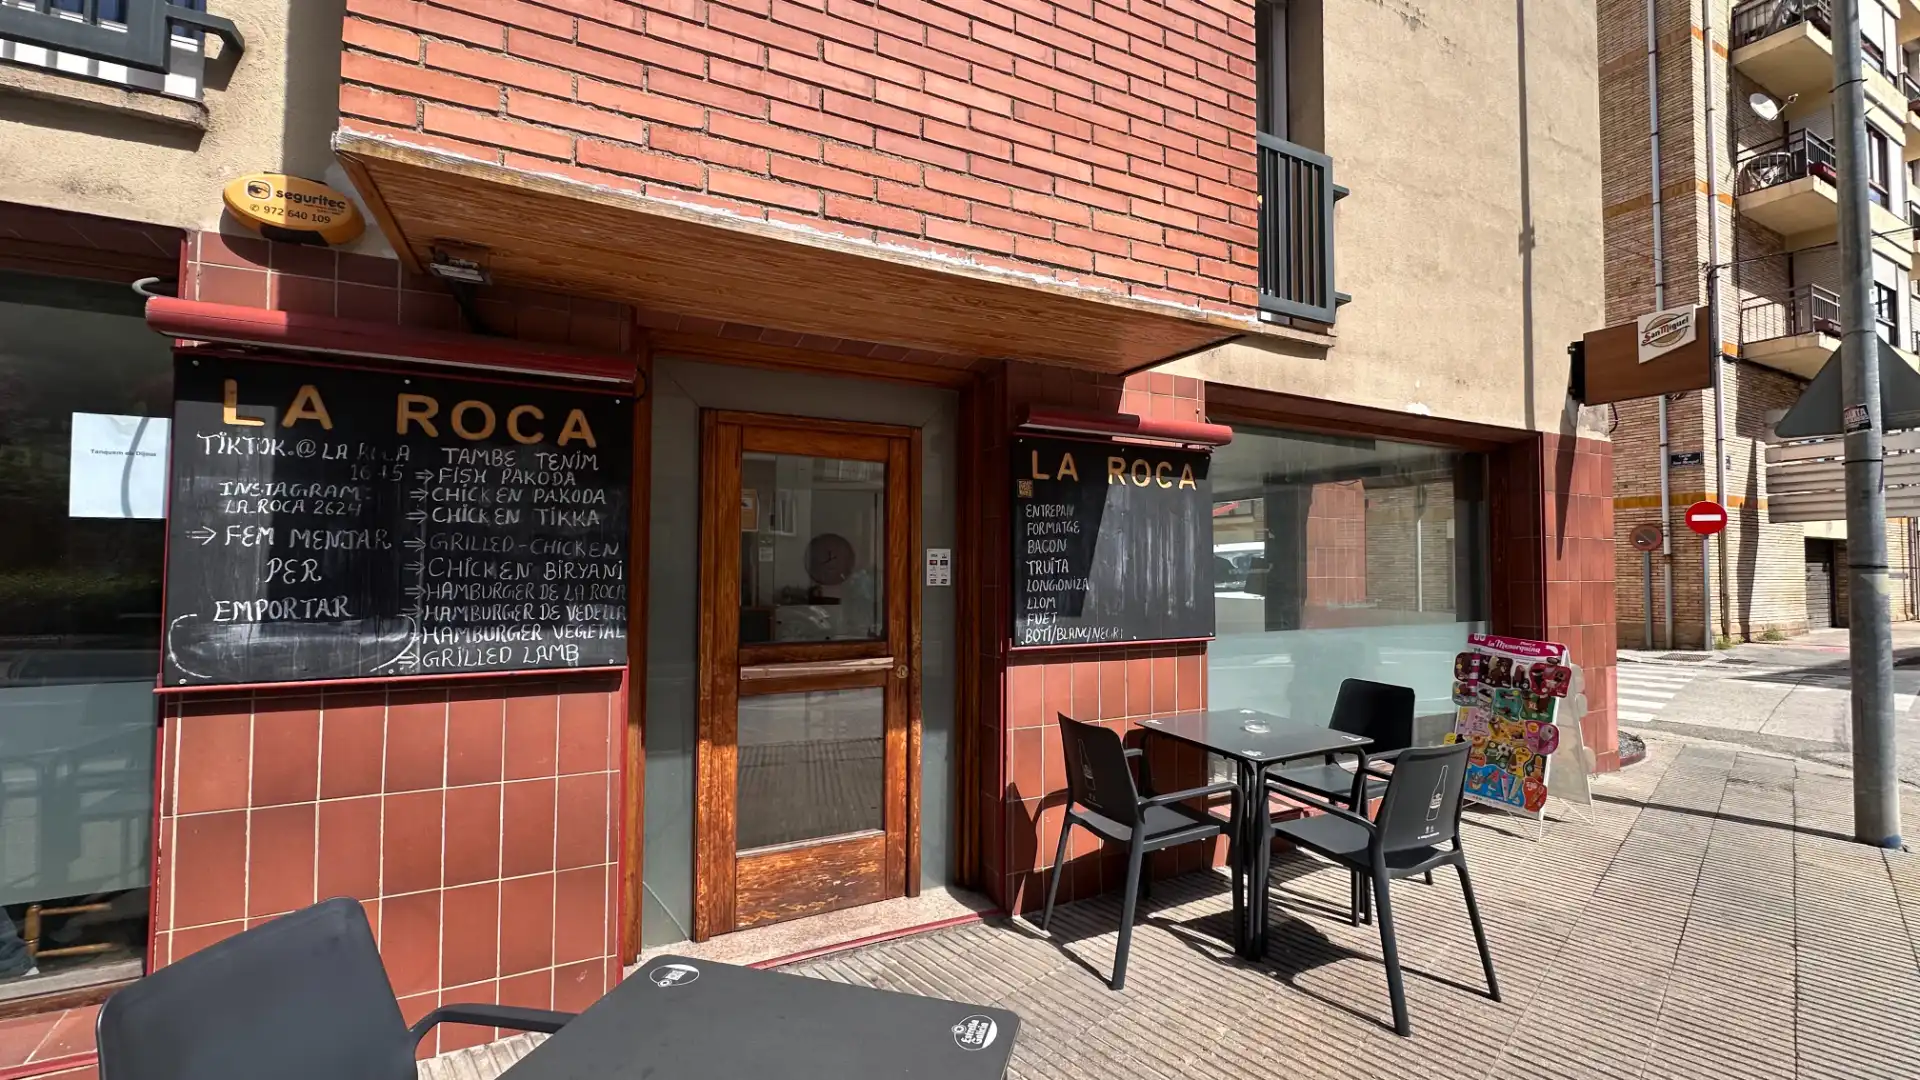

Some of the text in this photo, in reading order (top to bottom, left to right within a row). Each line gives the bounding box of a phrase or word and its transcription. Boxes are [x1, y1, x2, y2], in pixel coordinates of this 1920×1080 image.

[276, 189, 346, 210] seguritec
[263, 205, 284, 216] 972
[287, 209, 308, 220] 640
[311, 213, 331, 224] 109
[1642, 315, 1689, 344] San Miguel
[223, 378, 597, 449] LA ROCA
[321, 442, 348, 460] LA
[441, 447, 600, 472] TAMBE TENIM
[438, 467, 576, 486] FISH PAKODA
[1031, 449, 1197, 491] LA ROCA
[431, 484, 606, 506] CHICKEN PAKODA
[313, 500, 362, 516] 2624
[432, 503, 601, 528] CHICKEN TIKKA
[1025, 503, 1075, 518] ENTREPAN
[224, 524, 392, 550] FEM MENJAR
[1027, 520, 1080, 536] FORMATGE
[1027, 538, 1068, 555] BACON
[264, 557, 322, 584] PER
[428, 557, 623, 581] CHICKEN BIRYANI
[1026, 556, 1069, 576] TRUITA
[426, 581, 626, 601] HAMBURGER DE LA ROCA
[1026, 576, 1090, 592] LONGONIZA
[213, 595, 352, 622] EMPORTAR
[423, 602, 534, 623] HAMBURGER
[539, 603, 560, 621] DE
[1026, 596, 1056, 610] LLOM
[1027, 611, 1057, 626] FUET
[421, 623, 626, 645] HAMBURGER VEGETAL
[422, 644, 579, 668] GRILLED LAMB
[1495, 639, 1541, 655] Menorquina
[961, 1019, 980, 1044] Estrella
[971, 1022, 989, 1045] Galicia
